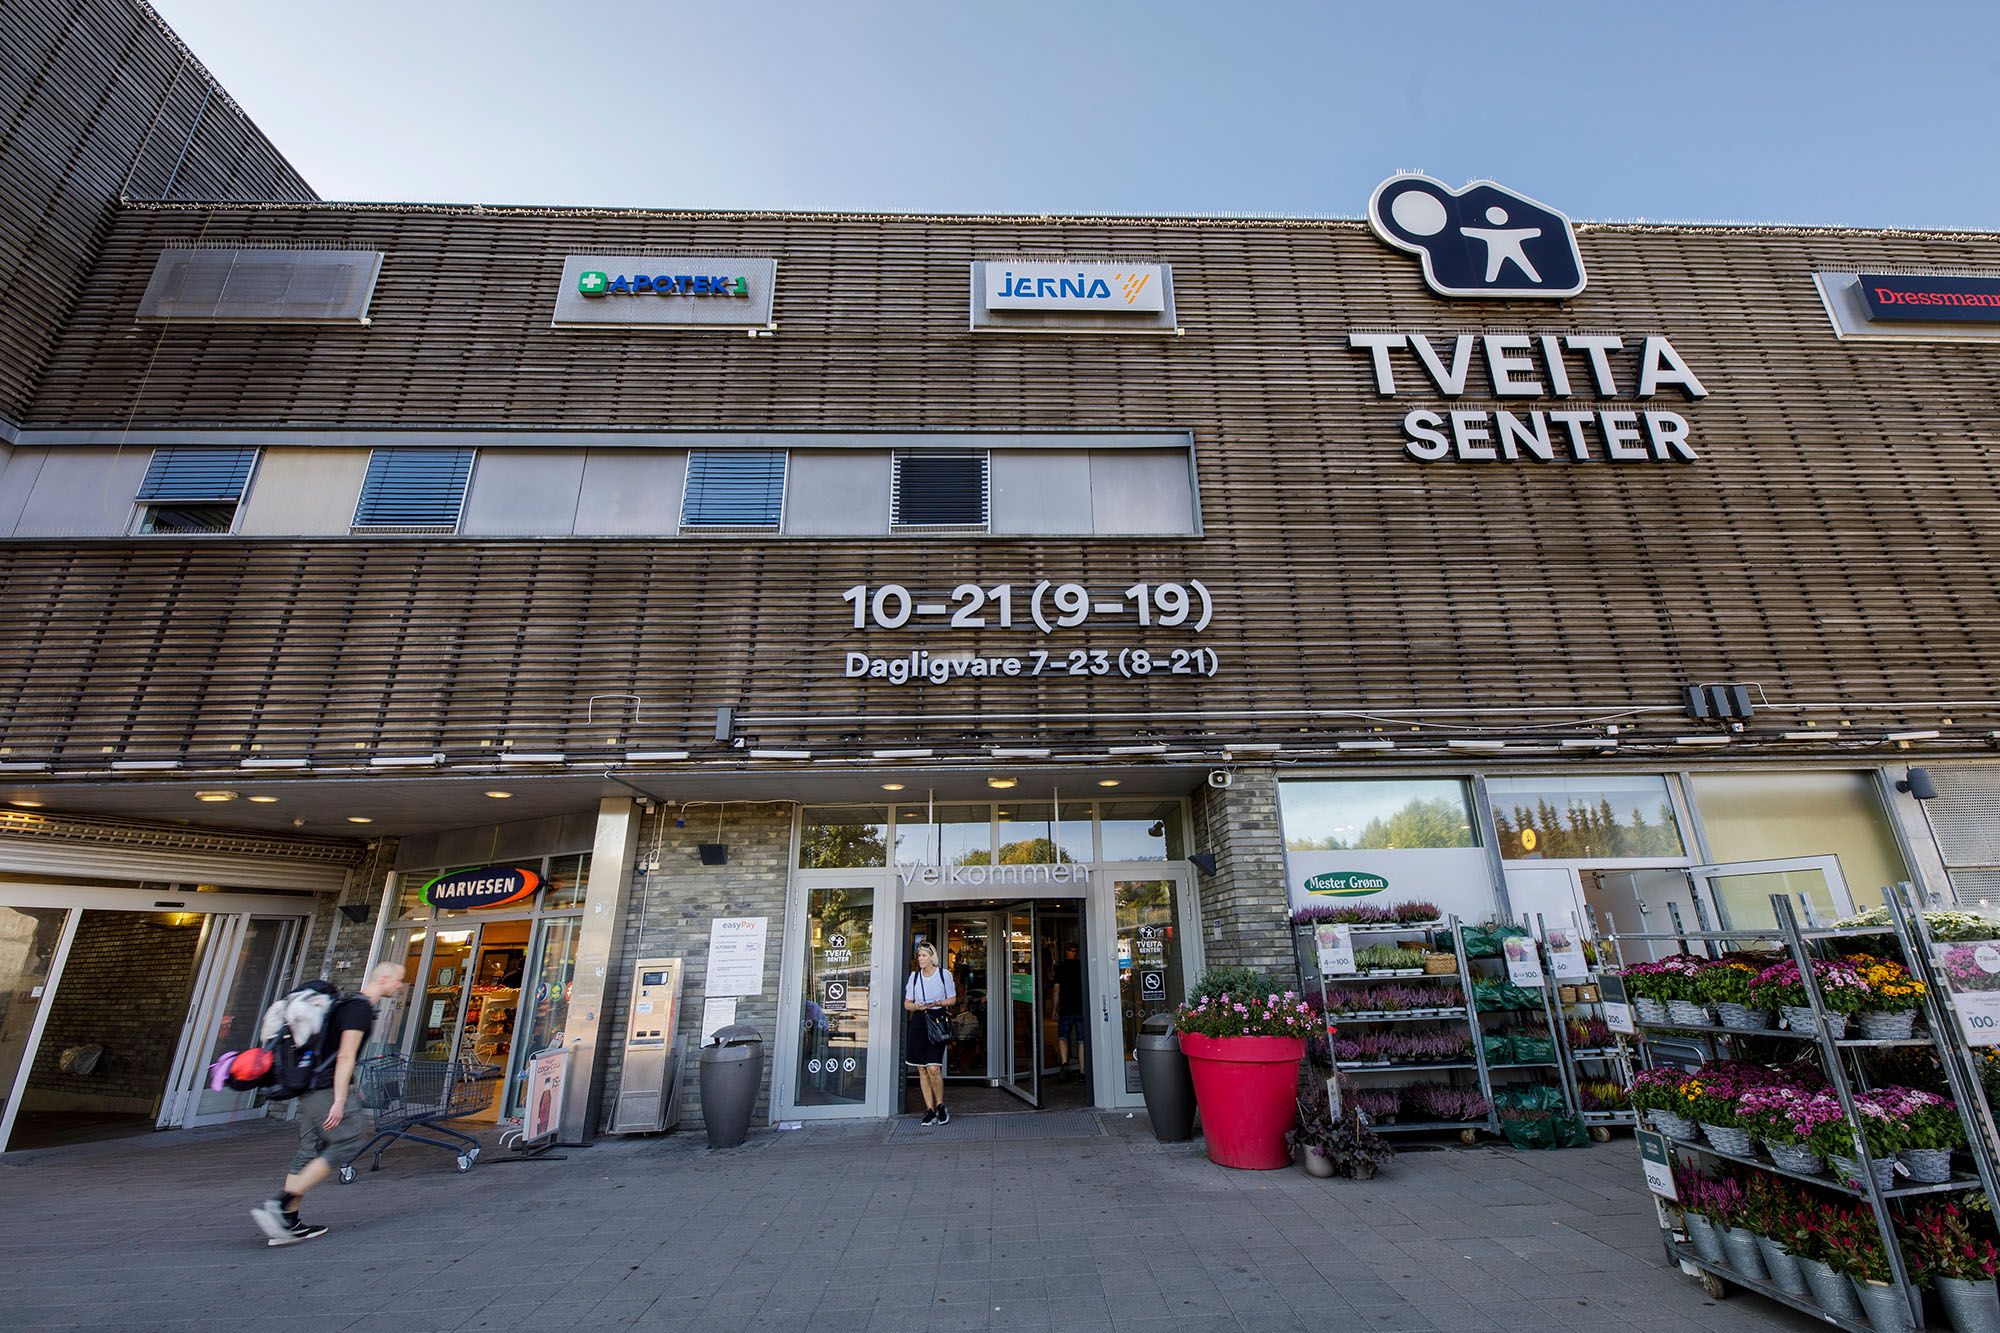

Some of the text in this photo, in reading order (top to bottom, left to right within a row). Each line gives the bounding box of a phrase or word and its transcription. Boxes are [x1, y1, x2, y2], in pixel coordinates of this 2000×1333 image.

[609, 275, 749, 297] APOTEK 1
[1348, 334, 1709, 400] TVEITA
[1402, 409, 1701, 464] SENTER
[845, 650, 1022, 685] Dagligvare
[898, 858, 1090, 888] Velkommen
[1309, 875, 1384, 889] Mester Grønn
[435, 877, 516, 899] NARVESEN
[722, 920, 756, 931] easyPay
[824, 949, 852, 957] TVEITA
[1136, 940, 1163, 948] TVEITA
